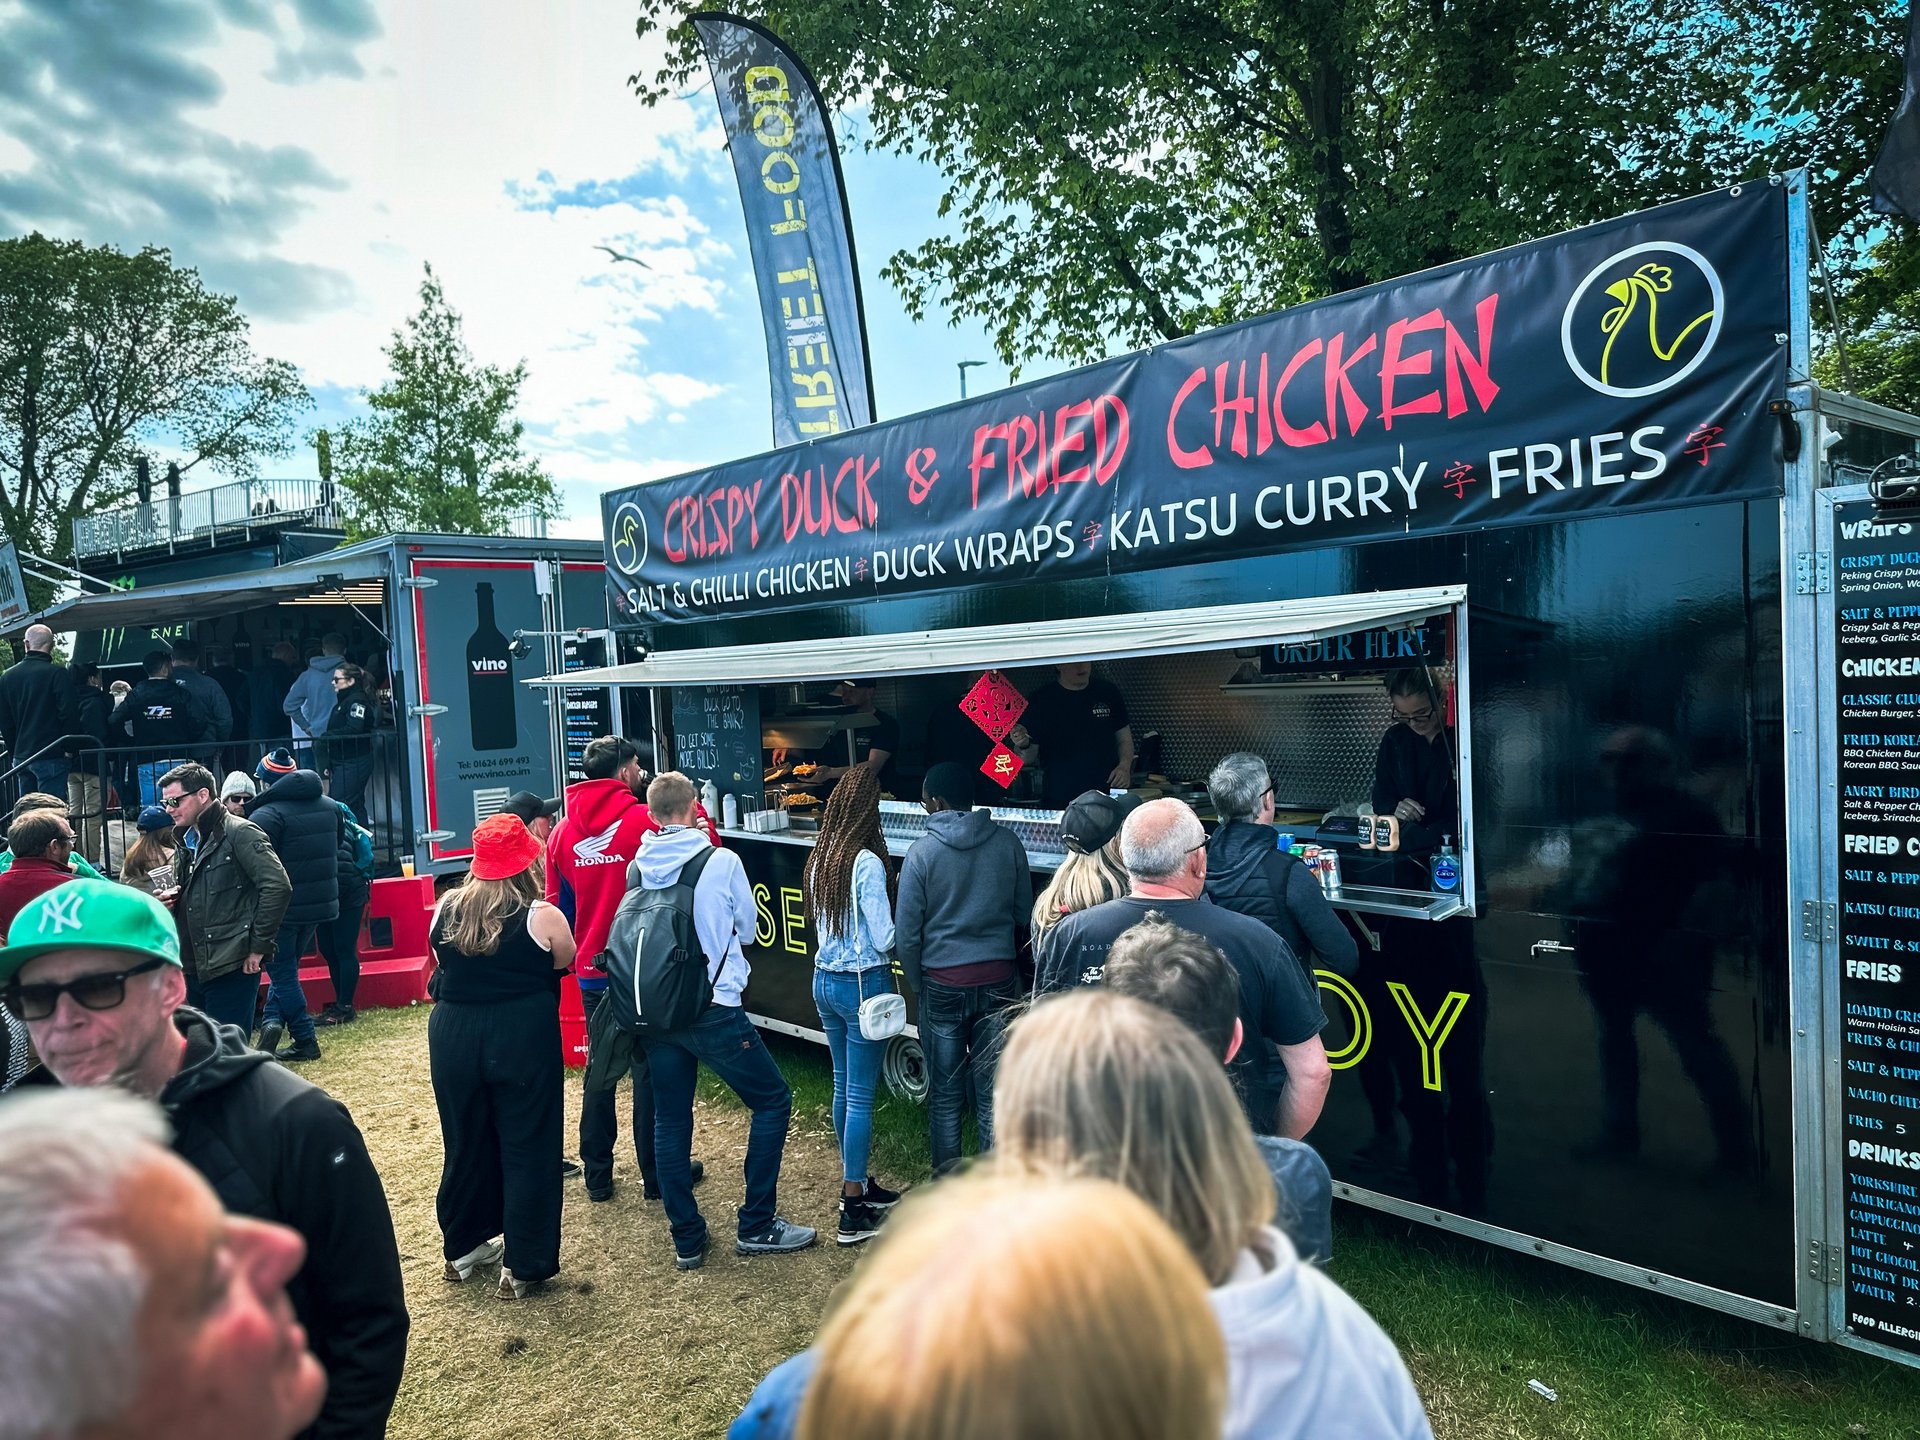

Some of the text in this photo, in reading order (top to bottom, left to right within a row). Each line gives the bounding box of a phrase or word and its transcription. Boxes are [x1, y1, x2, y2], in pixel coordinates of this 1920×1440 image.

[663, 293, 1500, 563] CRISPY DUCK & FRIED CHICKEN
[626, 584, 666, 614] SALT
[672, 581, 688, 608] &
[690, 571, 750, 606] CHILLI
[755, 556, 851, 598] CHICKEN
[873, 541, 947, 583] DUCK
[954, 520, 1075, 572] WRAPS
[1110, 492, 1237, 552] KATSU
[1254, 461, 1429, 530] CURRY
[1443, 461, 1477, 499] 字
[1488, 425, 1667, 499] FRIES
[1683, 423, 1727, 467] 字
[1840, 554, 1885, 568] CRISPY
[1840, 571, 1872, 580] Peking
[1873, 569, 1903, 579] Crispy
[1840, 583, 1871, 594] Spring
[1872, 581, 1904, 590] Onion,
[1841, 607, 1870, 620] SALT
[1873, 607, 1884, 619] &
[1841, 623, 1870, 633] Crispy
[1871, 622, 1890, 631] Salt
[1891, 621, 1900, 630] &
[1364, 627, 1431, 660] HERE
[1841, 635, 1878, 645] Iceberg,
[1880, 633, 1909, 642] Garlic
[471, 656, 508, 671] vino
[1842, 693, 1892, 706] CLASSIC
[707, 713, 719, 729] THE
[1842, 709, 1878, 717] Chicken
[1880, 709, 1914, 719] Burger,
[676, 734, 686, 751] TO
[1843, 734, 1880, 746] FRIED
[1843, 749, 1864, 758] BBQ
[1865, 749, 1902, 758] Chicken
[1843, 760, 1876, 769] Korean
[1878, 761, 1899, 770] BBQ
[1844, 785, 1885, 797] ANGRY
[1843, 800, 1862, 809] Salt
[1863, 800, 1872, 809] &
[1874, 801, 1908, 811] Pepper
[1844, 811, 1881, 823] Iceberg,
[1844, 834, 1900, 855] FRIED
[574, 854, 626, 867] HONDA
[1844, 869, 1873, 882] SALT
[1876, 871, 1887, 883] &
[1845, 902, 1885, 916] KATSU
[1845, 934, 1889, 949] SWEET
[1893, 939, 1905, 951] &
[1846, 959, 1901, 983] FRIES
[1846, 1003, 1892, 1019] LOADED
[1847, 1017, 1875, 1029] Warm
[1877, 1021, 1907, 1033] Hoisin
[1847, 1031, 1882, 1047] FRIES
[1886, 1037, 1897, 1049] &
[1847, 1059, 1875, 1073] SALT
[1878, 1064, 1889, 1076] &
[1848, 1086, 1887, 1103] NACHO
[1848, 1113, 1883, 1130] FRIES
[1848, 1139, 1920, 1170] DRINKS
[1849, 1172, 1918, 1197] YORKSHIRE
[1850, 1191, 1920, 1216] AMERICANO
[1849, 1209, 1920, 1235] CAPPUCCINO
[1850, 1226, 1887, 1245] LATTE
[1851, 1244, 1873, 1260] HOT
[1851, 1263, 1897, 1285] ENERGY
[1852, 1280, 1920, 1307] WATER 2.
[1852, 1312, 1875, 1327] FOOD
